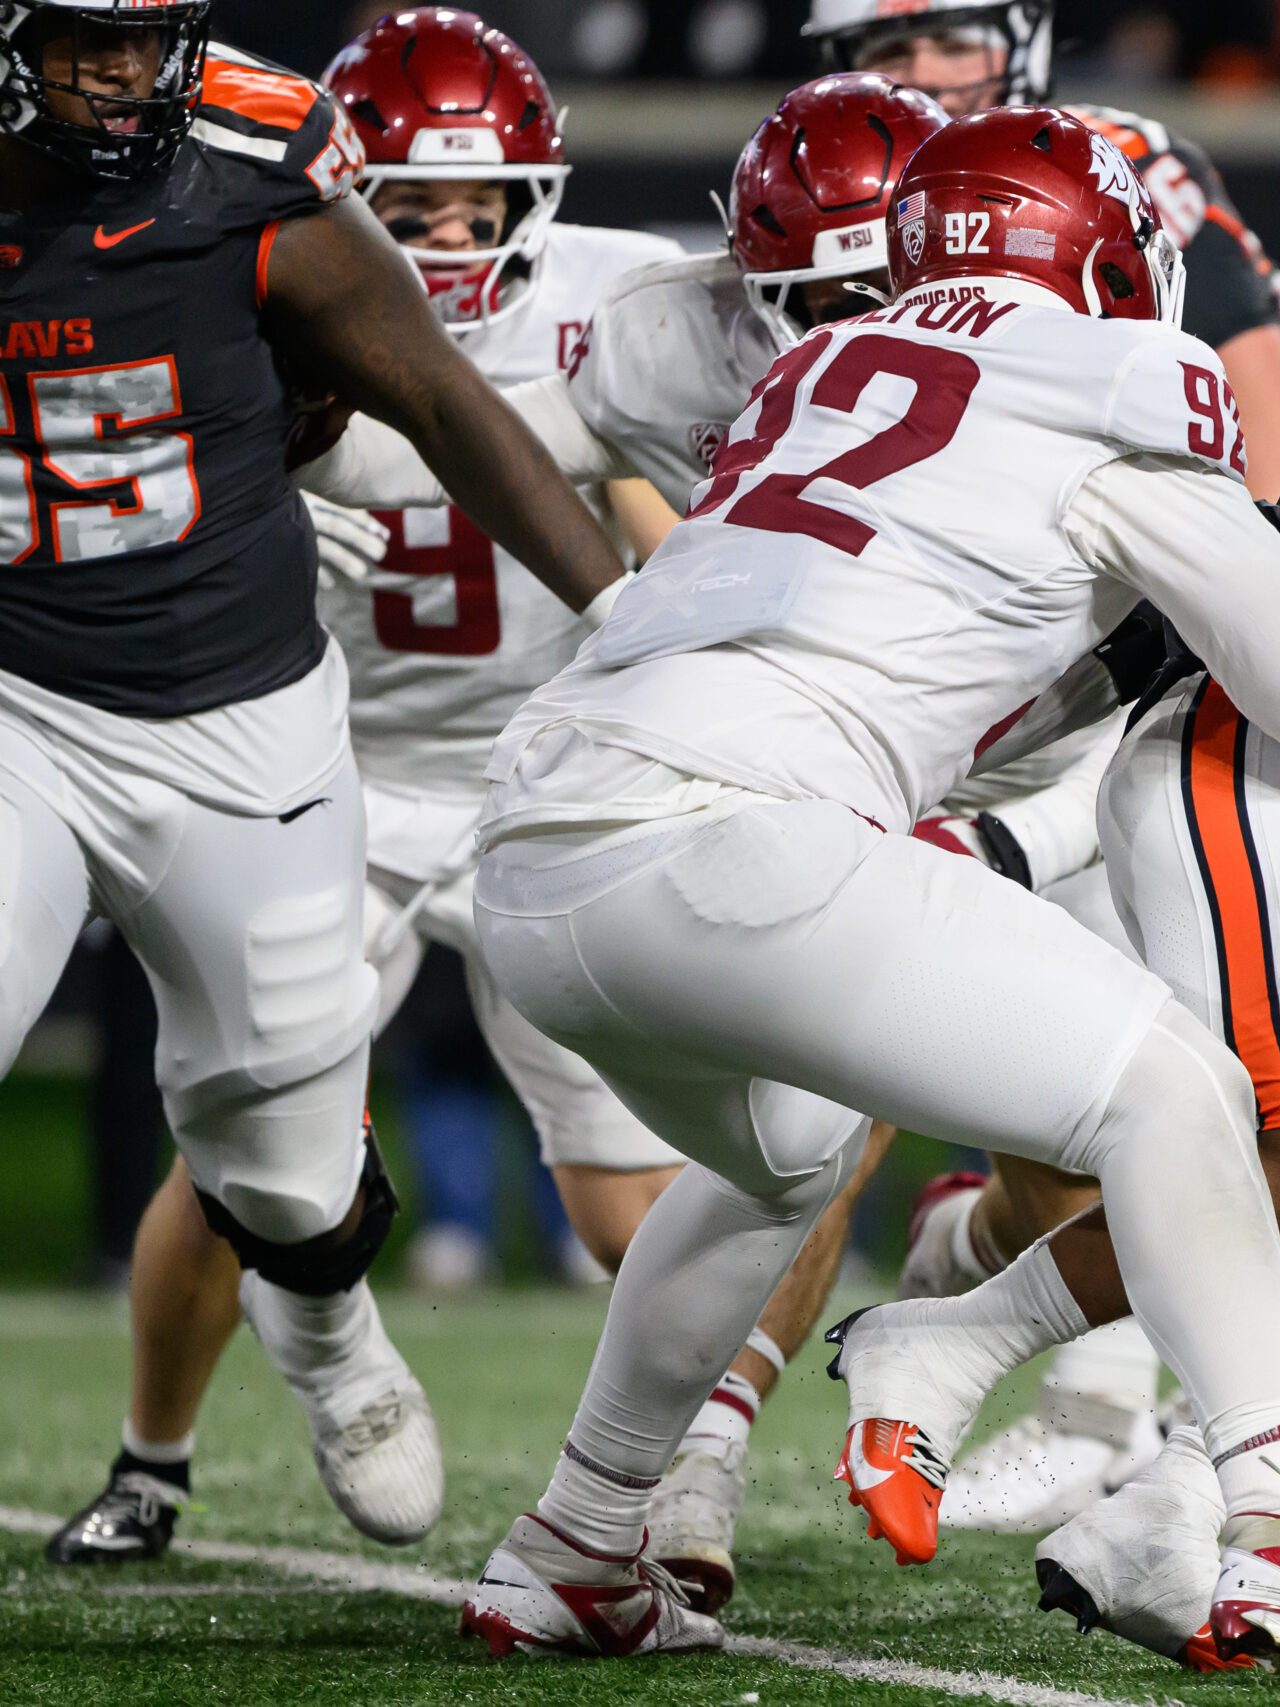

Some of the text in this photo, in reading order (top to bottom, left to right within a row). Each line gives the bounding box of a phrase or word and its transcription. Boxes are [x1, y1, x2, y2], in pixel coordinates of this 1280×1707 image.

[837, 227, 873, 252] WSU
[945, 212, 990, 255] 92
[0, 318, 95, 359] AVS
[1176, 360, 1246, 478] 92
[684, 331, 981, 557] 92
